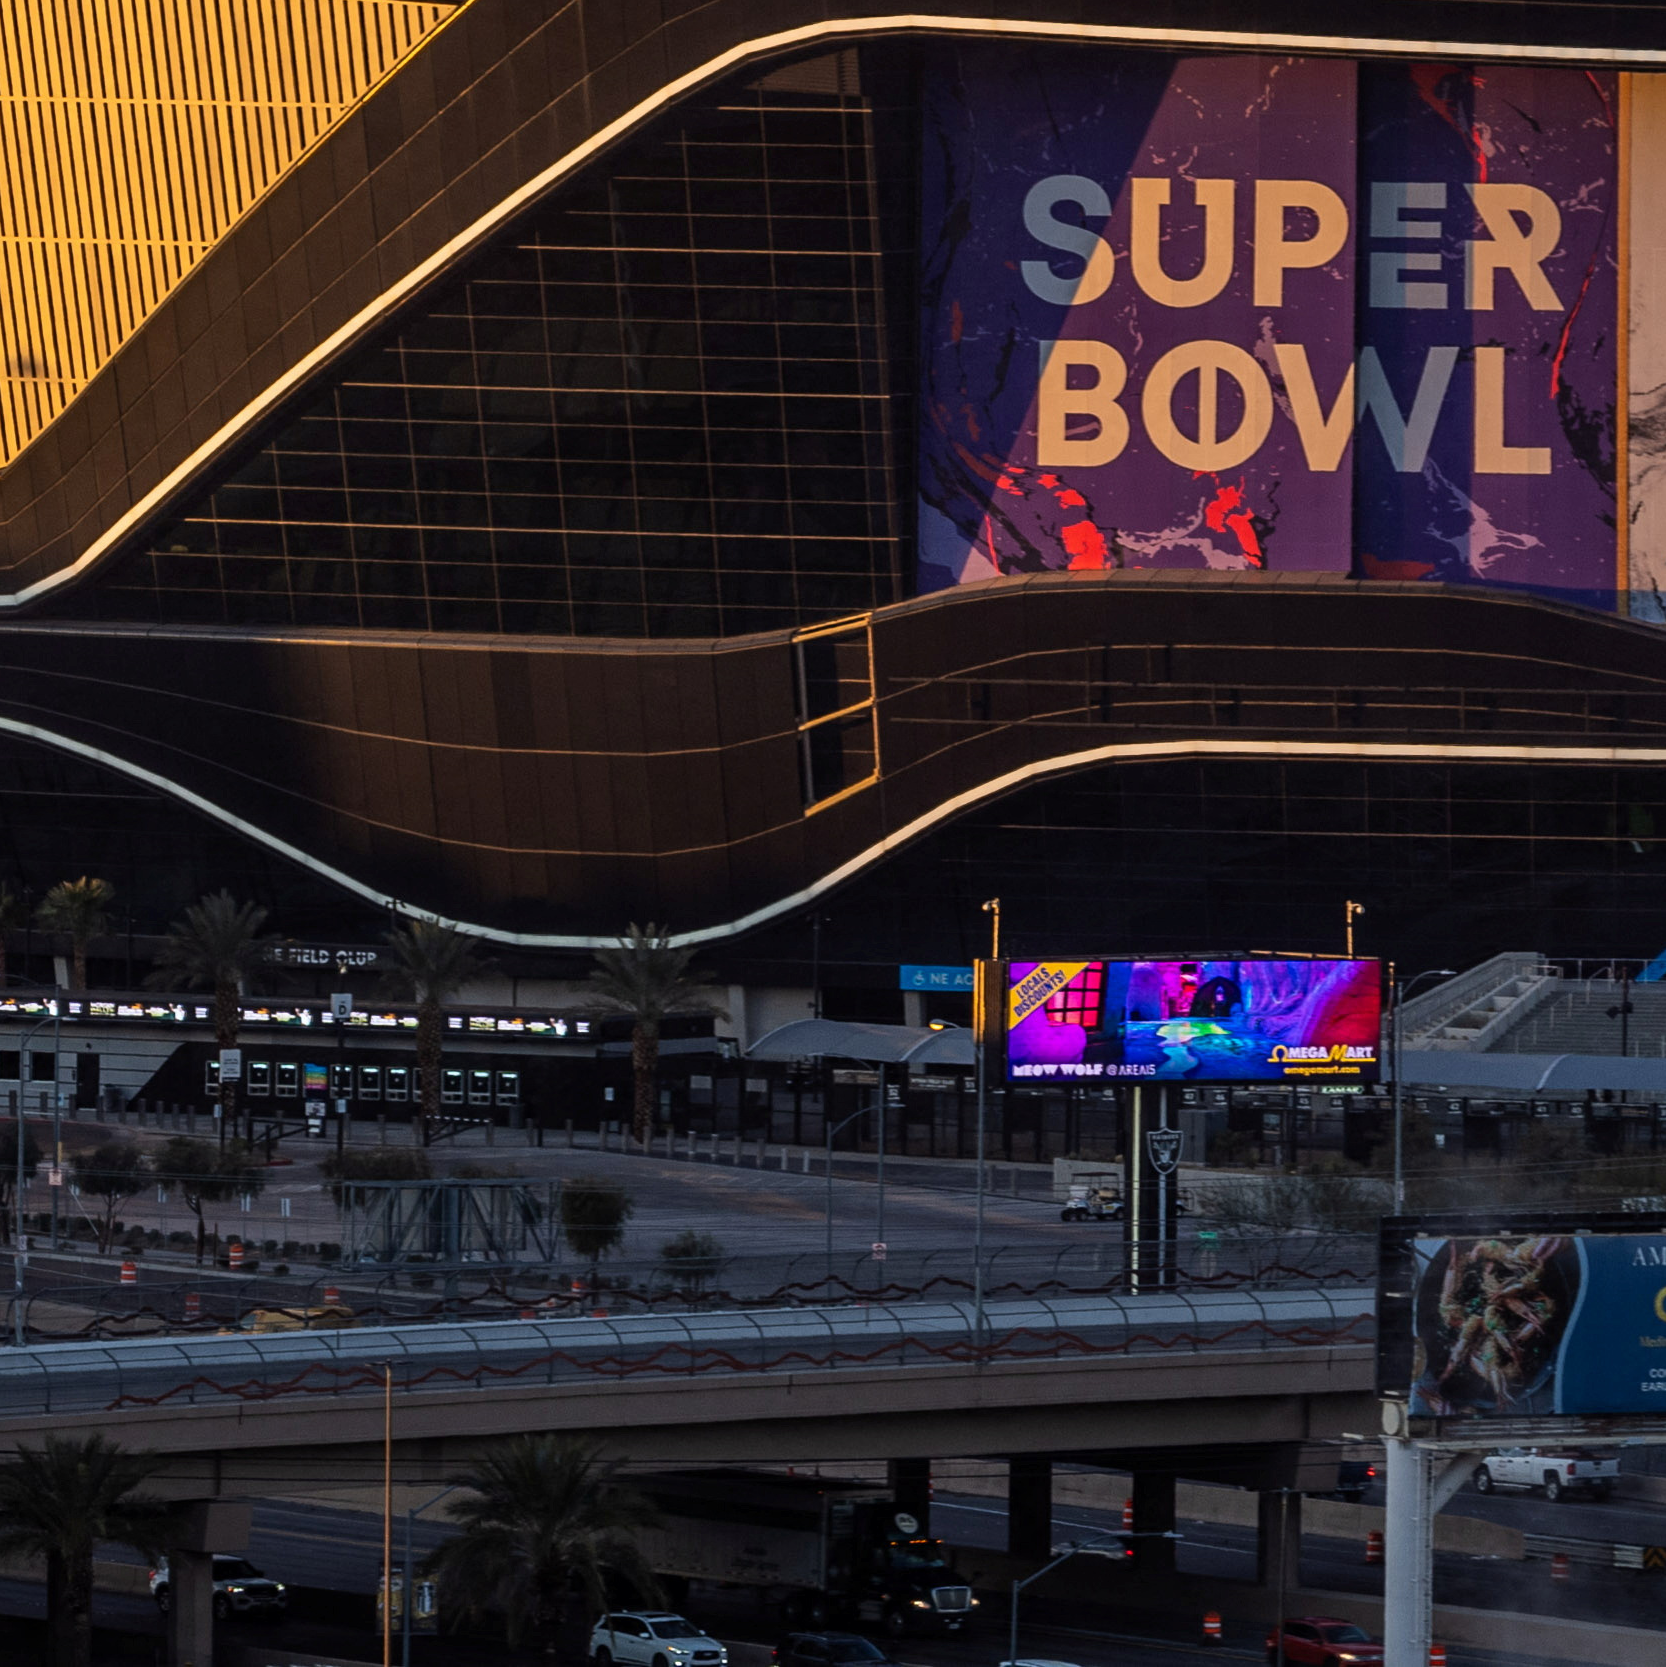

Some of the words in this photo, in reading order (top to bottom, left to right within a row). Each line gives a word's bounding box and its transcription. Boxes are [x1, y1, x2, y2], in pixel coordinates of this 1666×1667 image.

[1021, 174, 1566, 313] SUPER
[1035, 339, 1552, 476] BOWL
[930, 973, 950, 985] NE
[1012, 969, 1067, 1018] DISCOUNTS!
[1016, 967, 1051, 1000] LOCALS
[338, 1004, 347, 1016] D
[1632, 1247, 1646, 1267] A
